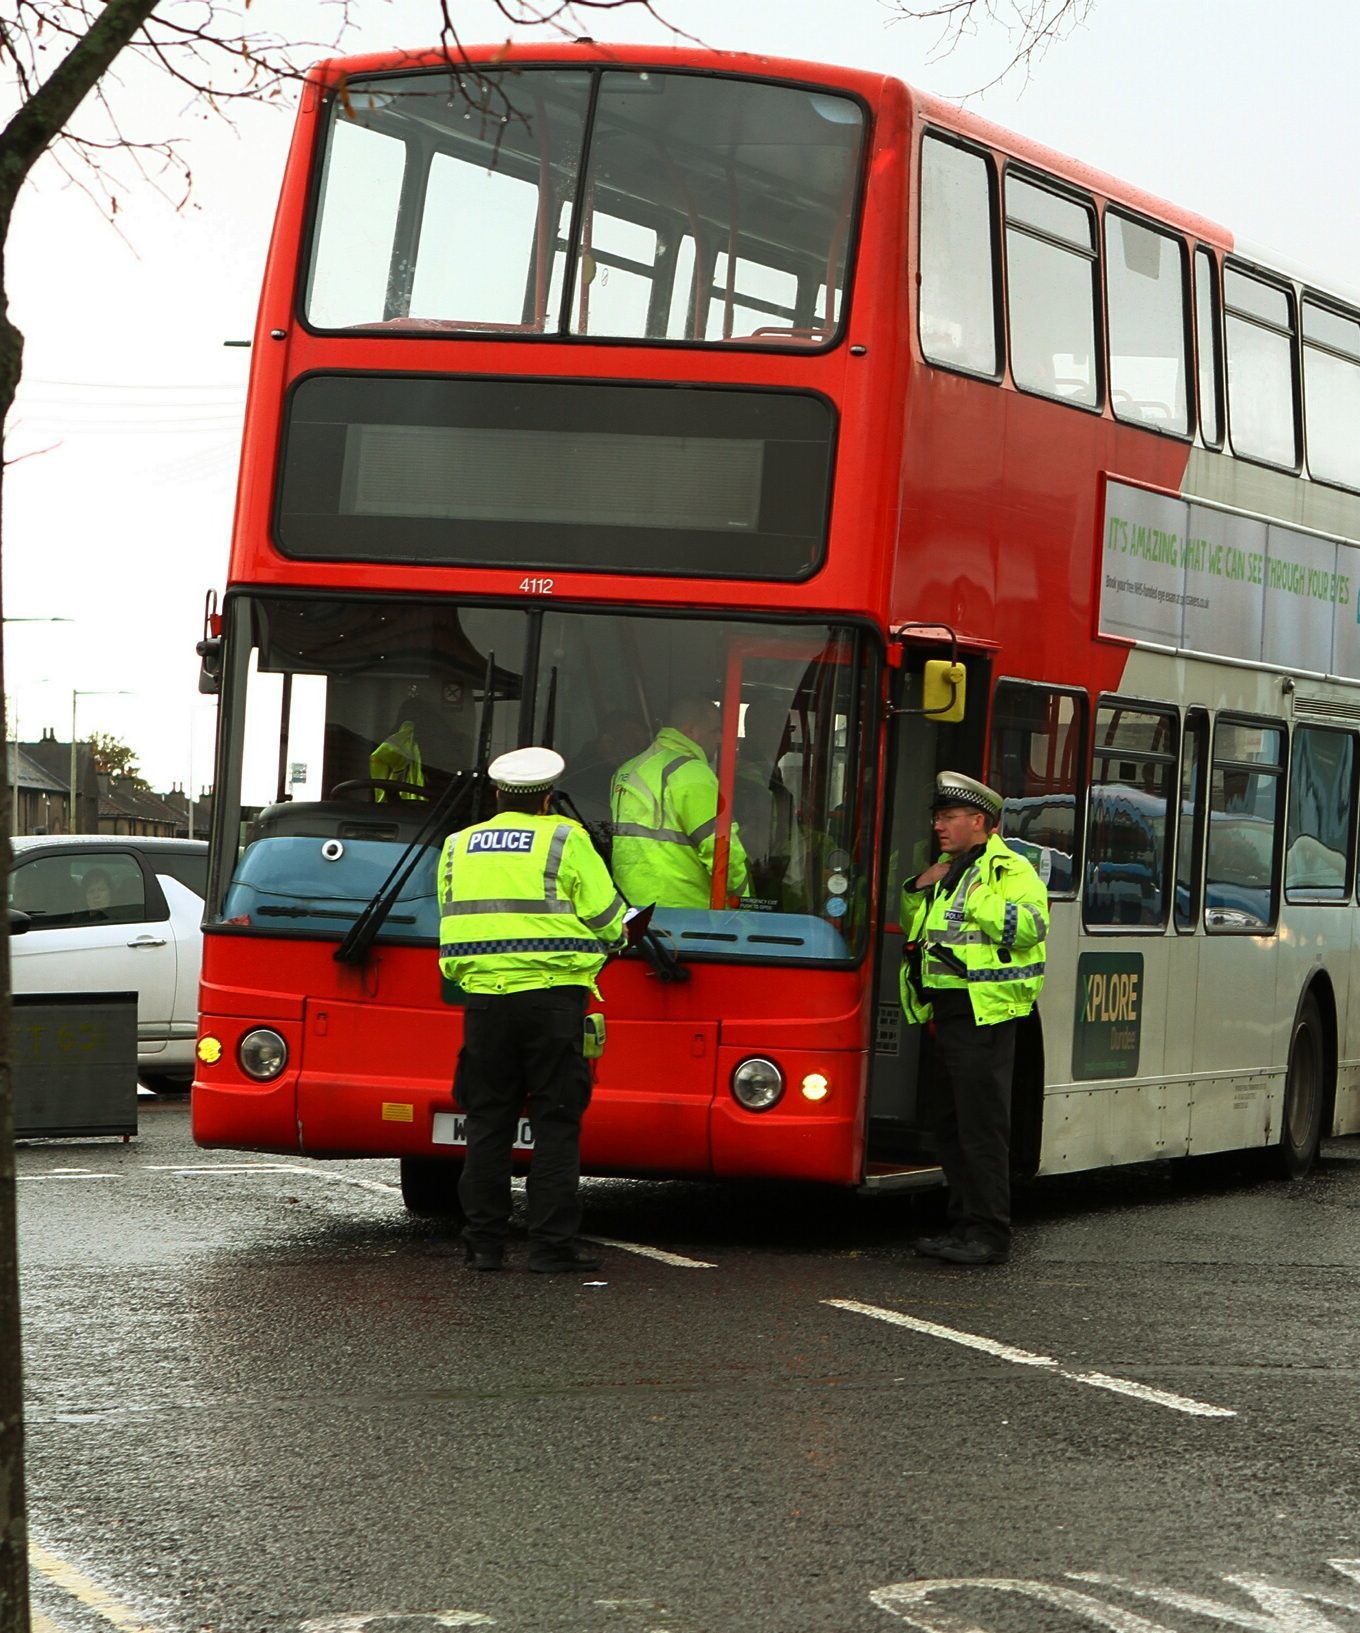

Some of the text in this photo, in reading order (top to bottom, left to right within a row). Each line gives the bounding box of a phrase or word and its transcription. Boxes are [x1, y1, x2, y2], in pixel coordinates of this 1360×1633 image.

[1129, 523, 1177, 568] AMAZING
[1208, 543, 1223, 576] WE
[1225, 546, 1246, 581] CAN
[1248, 552, 1263, 585] SEE
[1265, 556, 1306, 596] THROUGH
[1307, 567, 1329, 601] YOUR
[519, 577, 554, 594] 4112
[469, 831, 532, 850] POLICE
[1080, 973, 1138, 1022] XPLORE
[1110, 1026, 1136, 1051] Dundee
